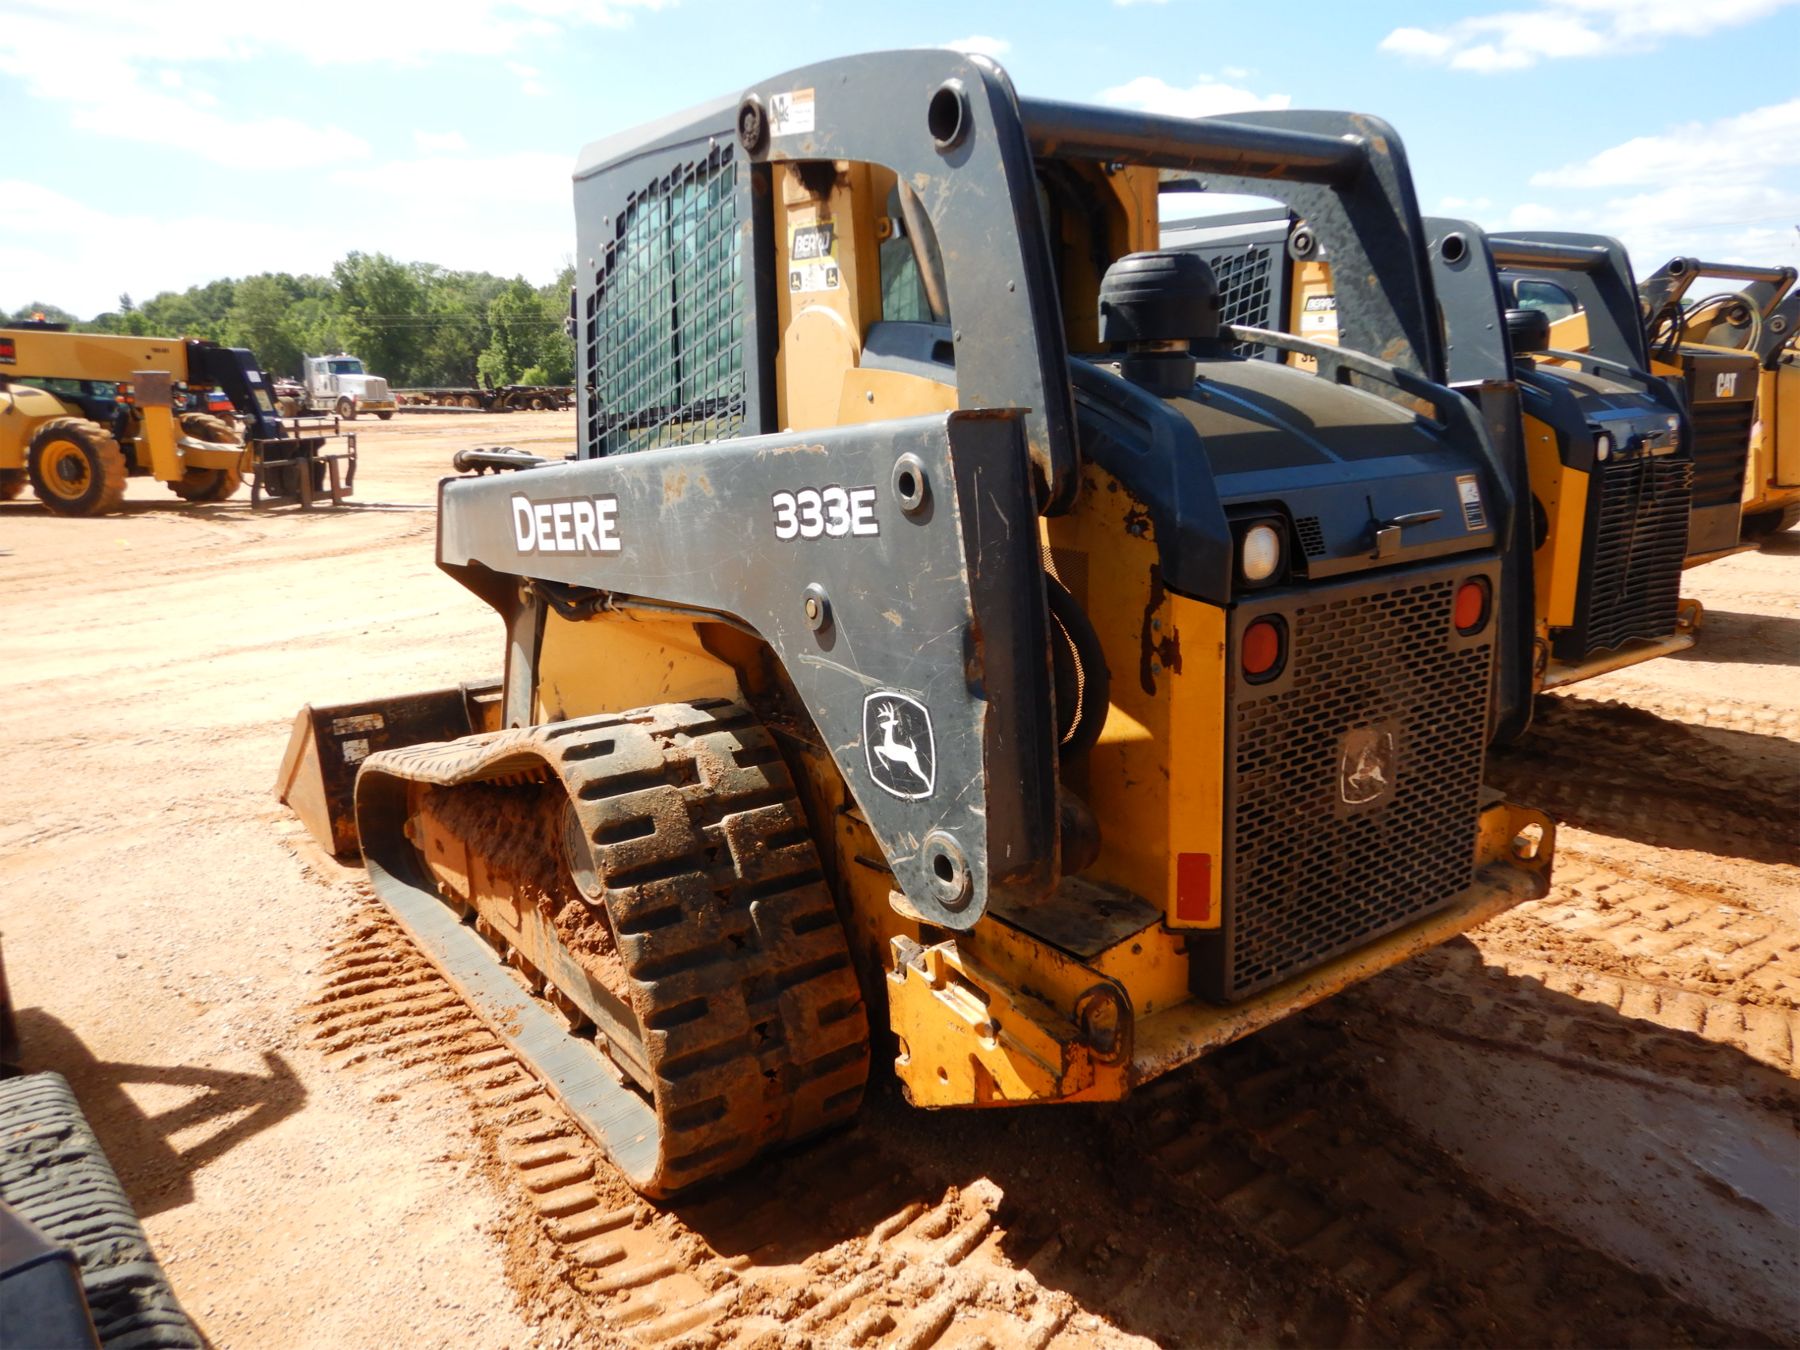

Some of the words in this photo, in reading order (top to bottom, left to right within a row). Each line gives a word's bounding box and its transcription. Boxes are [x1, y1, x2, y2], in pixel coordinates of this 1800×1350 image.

[1716, 372, 1737, 397] CAT
[511, 496, 622, 552] DEERE
[772, 487, 879, 541] 333E
